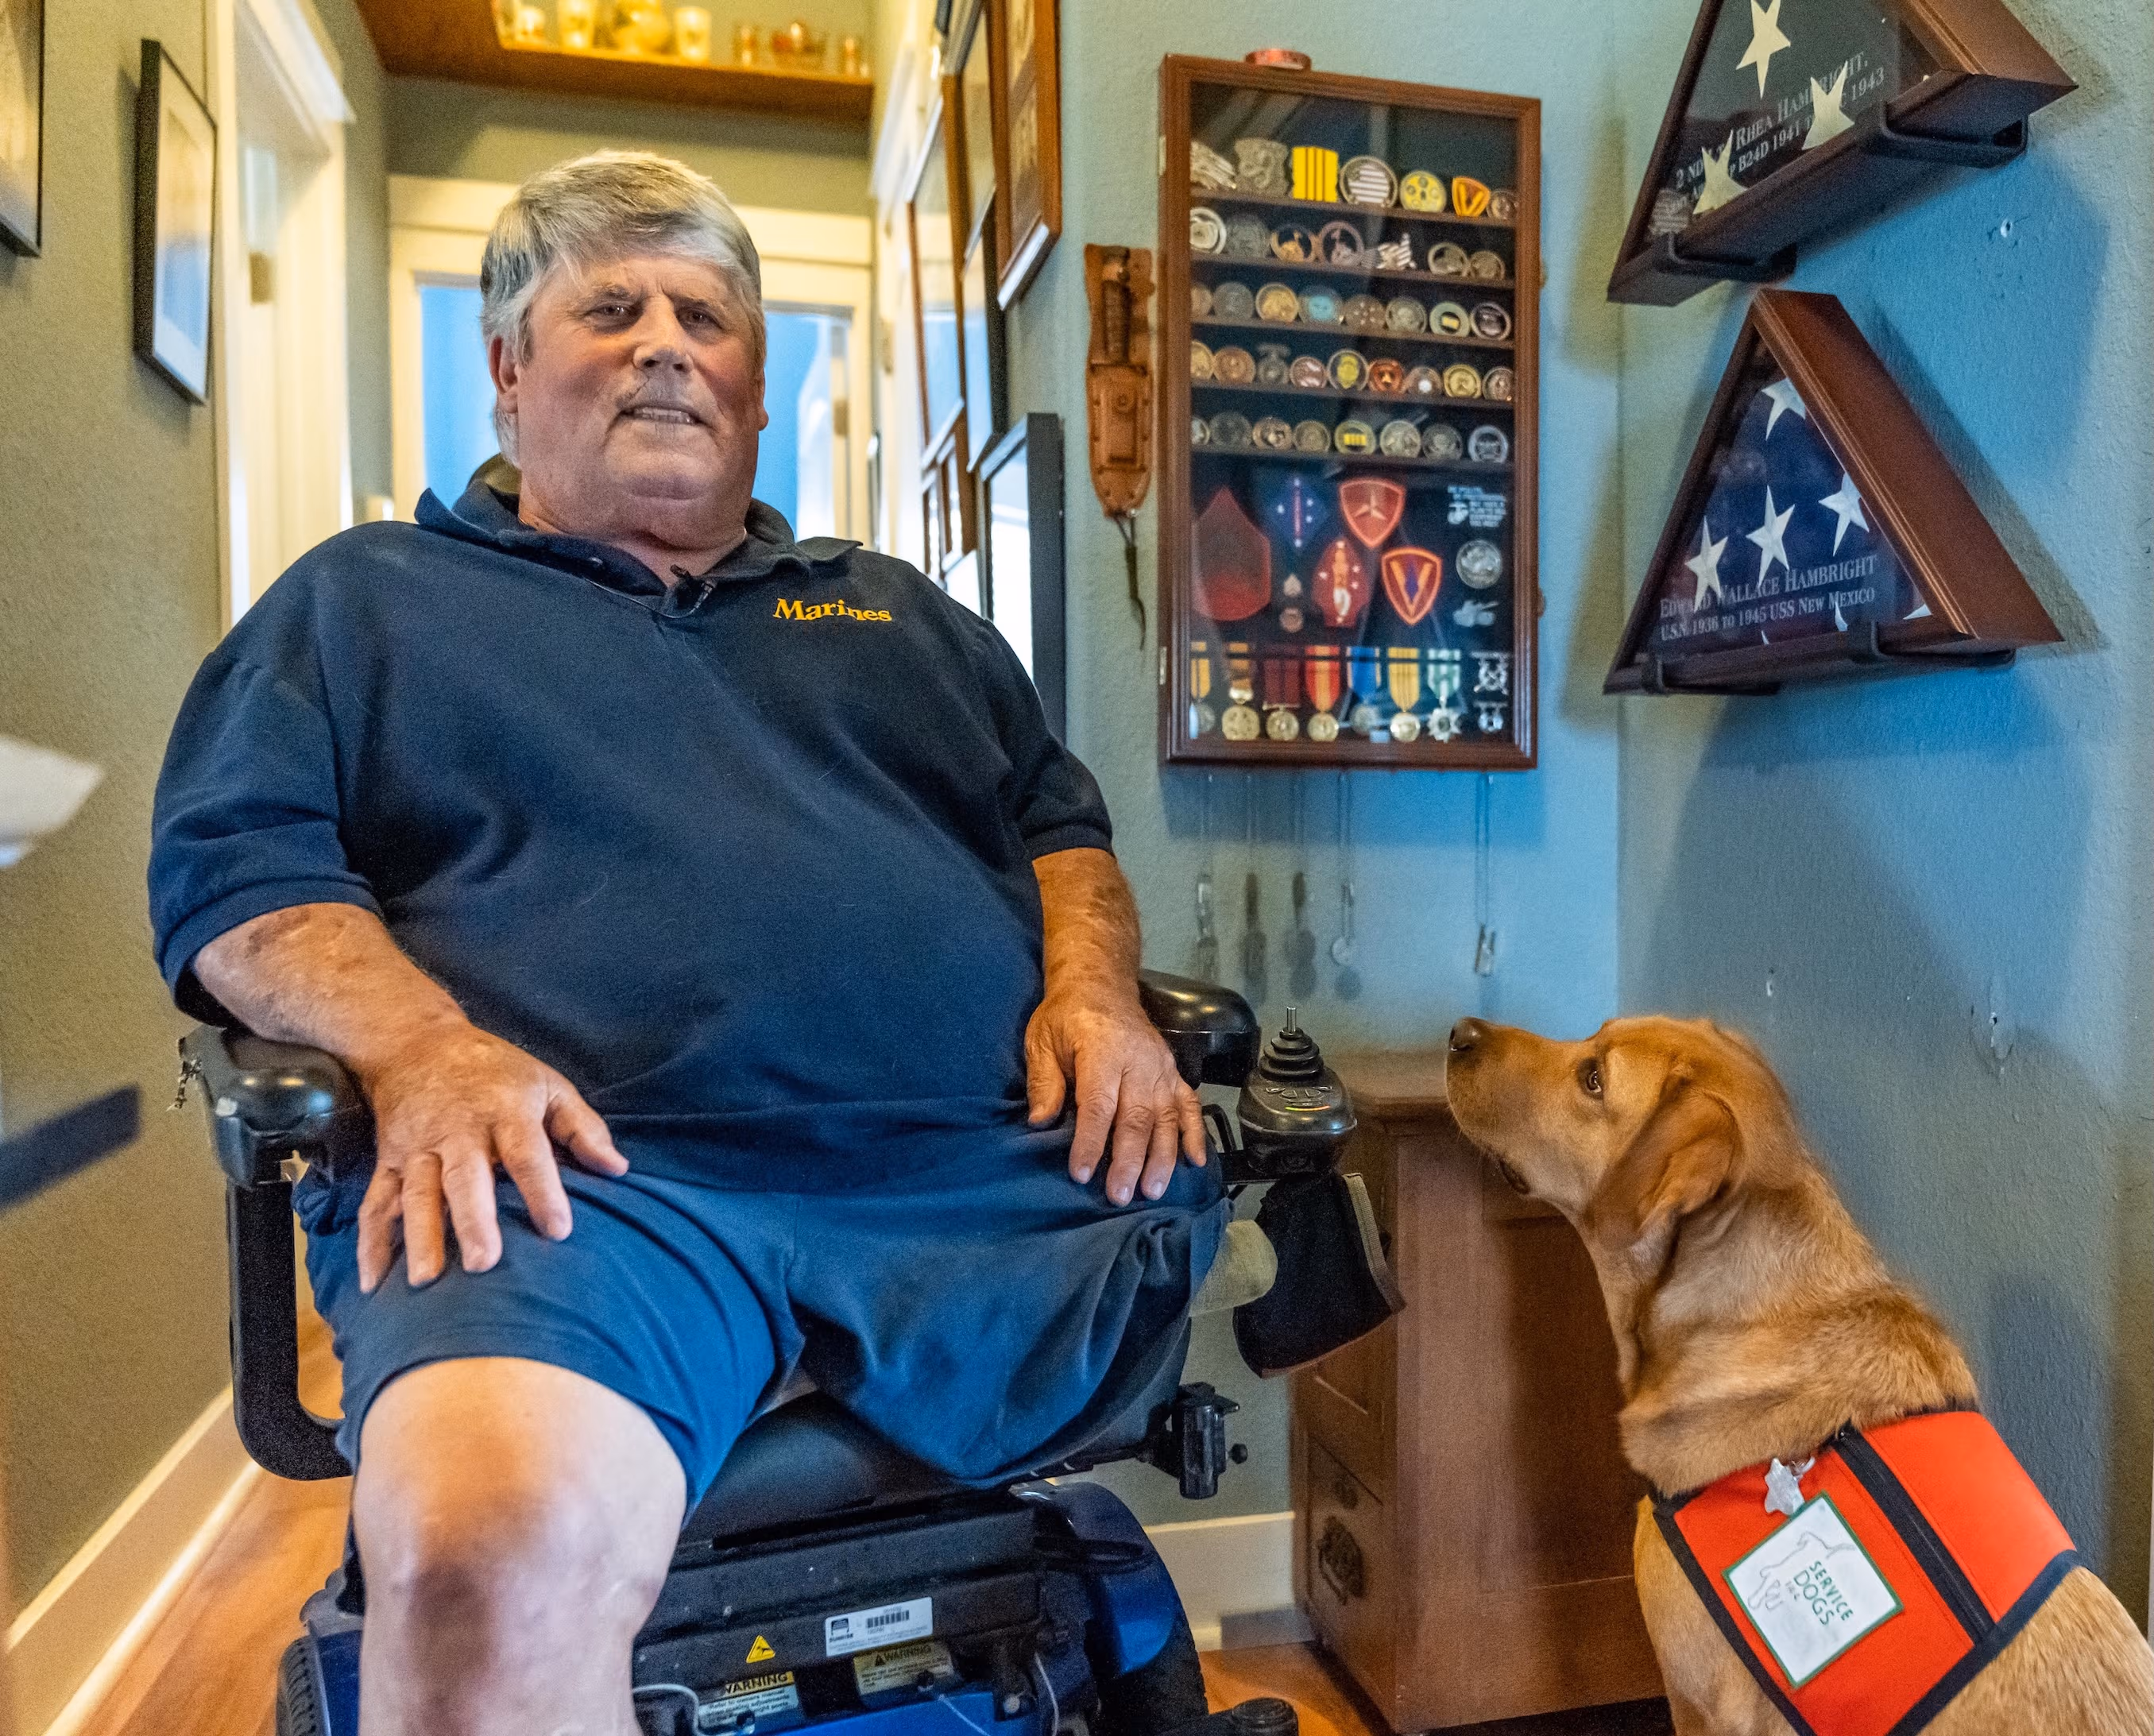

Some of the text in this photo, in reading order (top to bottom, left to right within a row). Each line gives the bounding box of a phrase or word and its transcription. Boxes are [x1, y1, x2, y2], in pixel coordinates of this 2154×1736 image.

[1735, 116, 1773, 151] RHEA
[1777, 51, 1868, 124] HAMRIHT.
[1738, 141, 1769, 173] B24D
[1773, 120, 1800, 151] 1941
[1851, 67, 1885, 102] 1943
[772, 597, 892, 621] Marines
[1660, 593, 1711, 619] EDWAD
[1785, 555, 1877, 593] HAMBRIGHT
[1692, 615, 1719, 636] 1936
[1738, 606, 1766, 627] 1945
[1770, 600, 1795, 621] USS
[1798, 597, 1825, 615] NEW
[1828, 587, 1875, 610] MEXICO
[1793, 1569, 1834, 1625] DOGS
[1809, 1560, 1853, 1621] SERVICE
